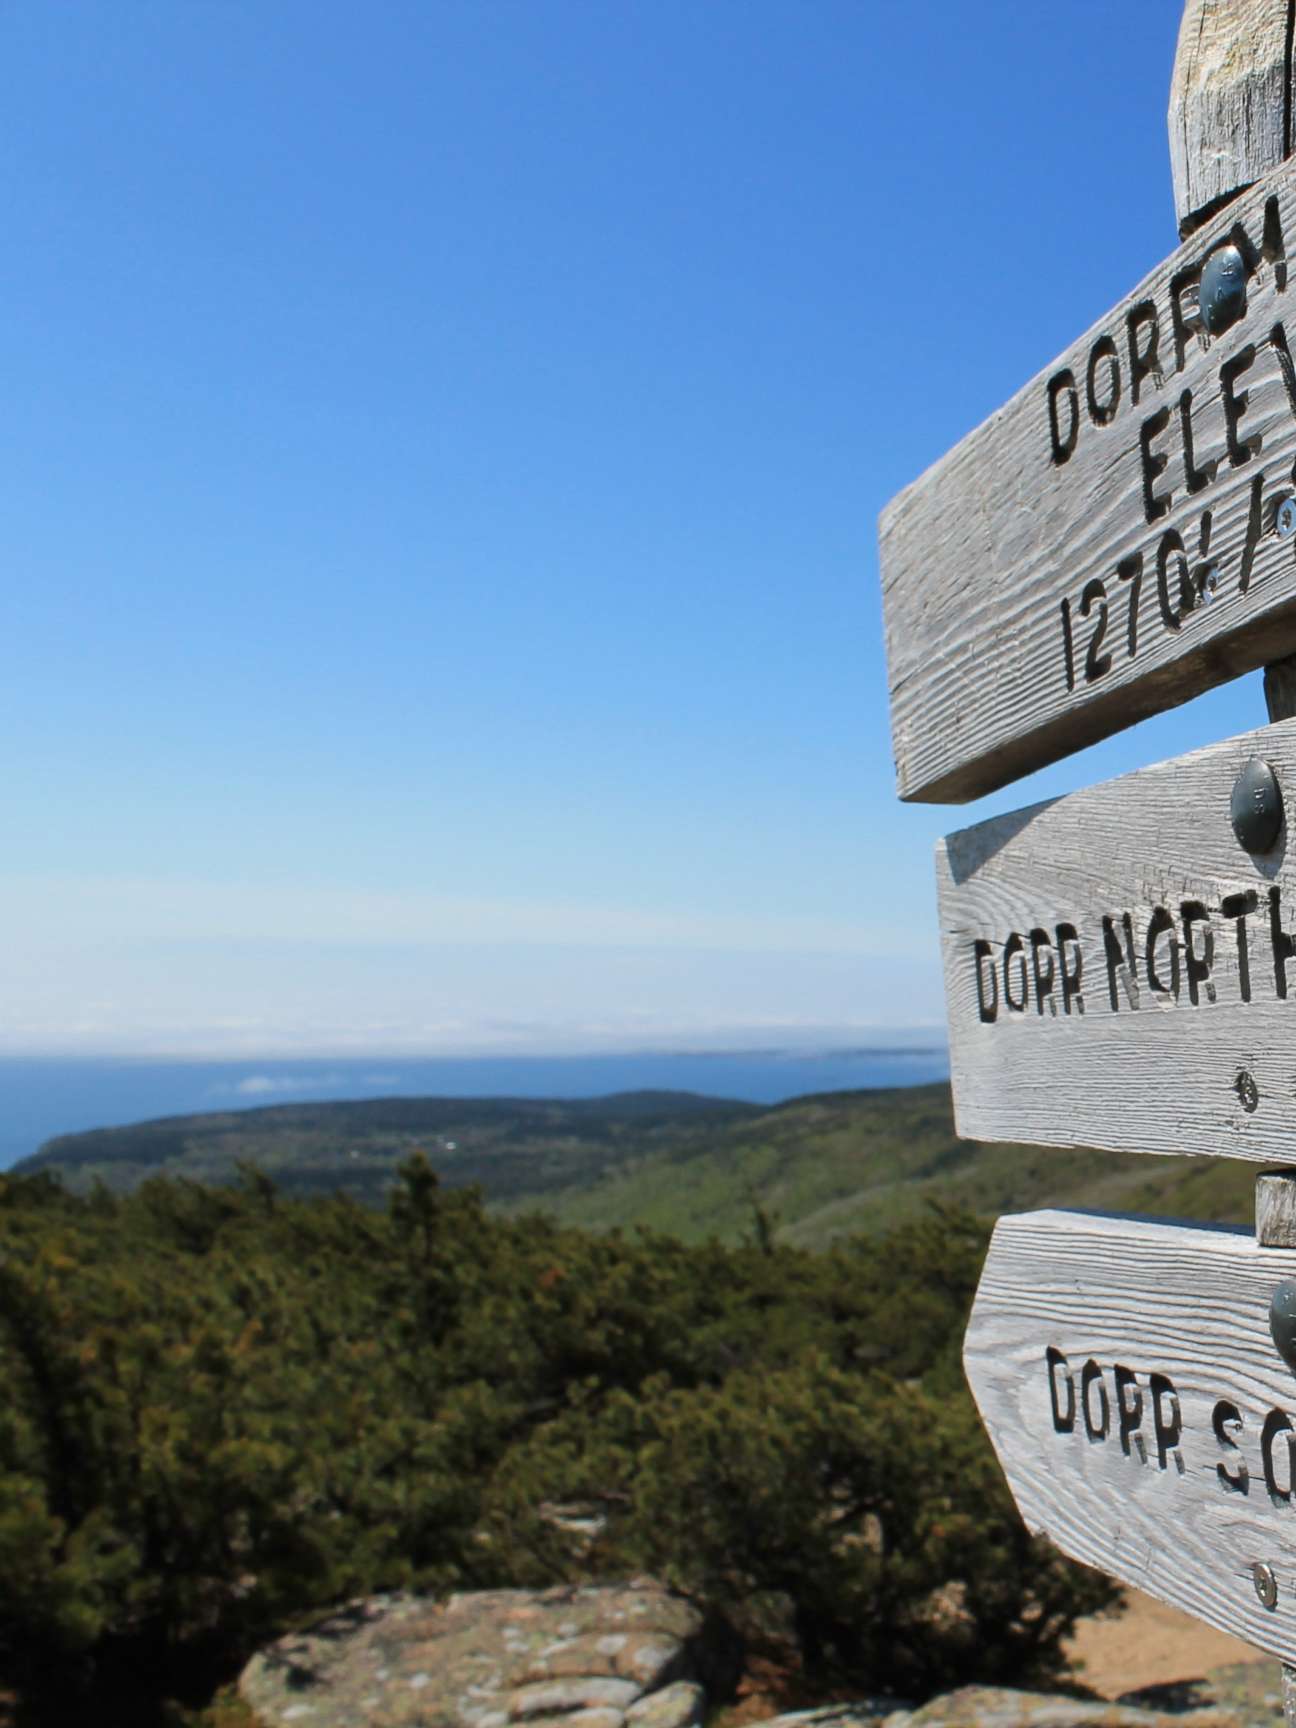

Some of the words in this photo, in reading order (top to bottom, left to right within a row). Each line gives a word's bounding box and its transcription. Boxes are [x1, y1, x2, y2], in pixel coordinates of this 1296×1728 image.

[1047, 262, 1211, 466] DORR
[974, 922, 1083, 1023] DORR
[1046, 1345, 1184, 1475] DORR
